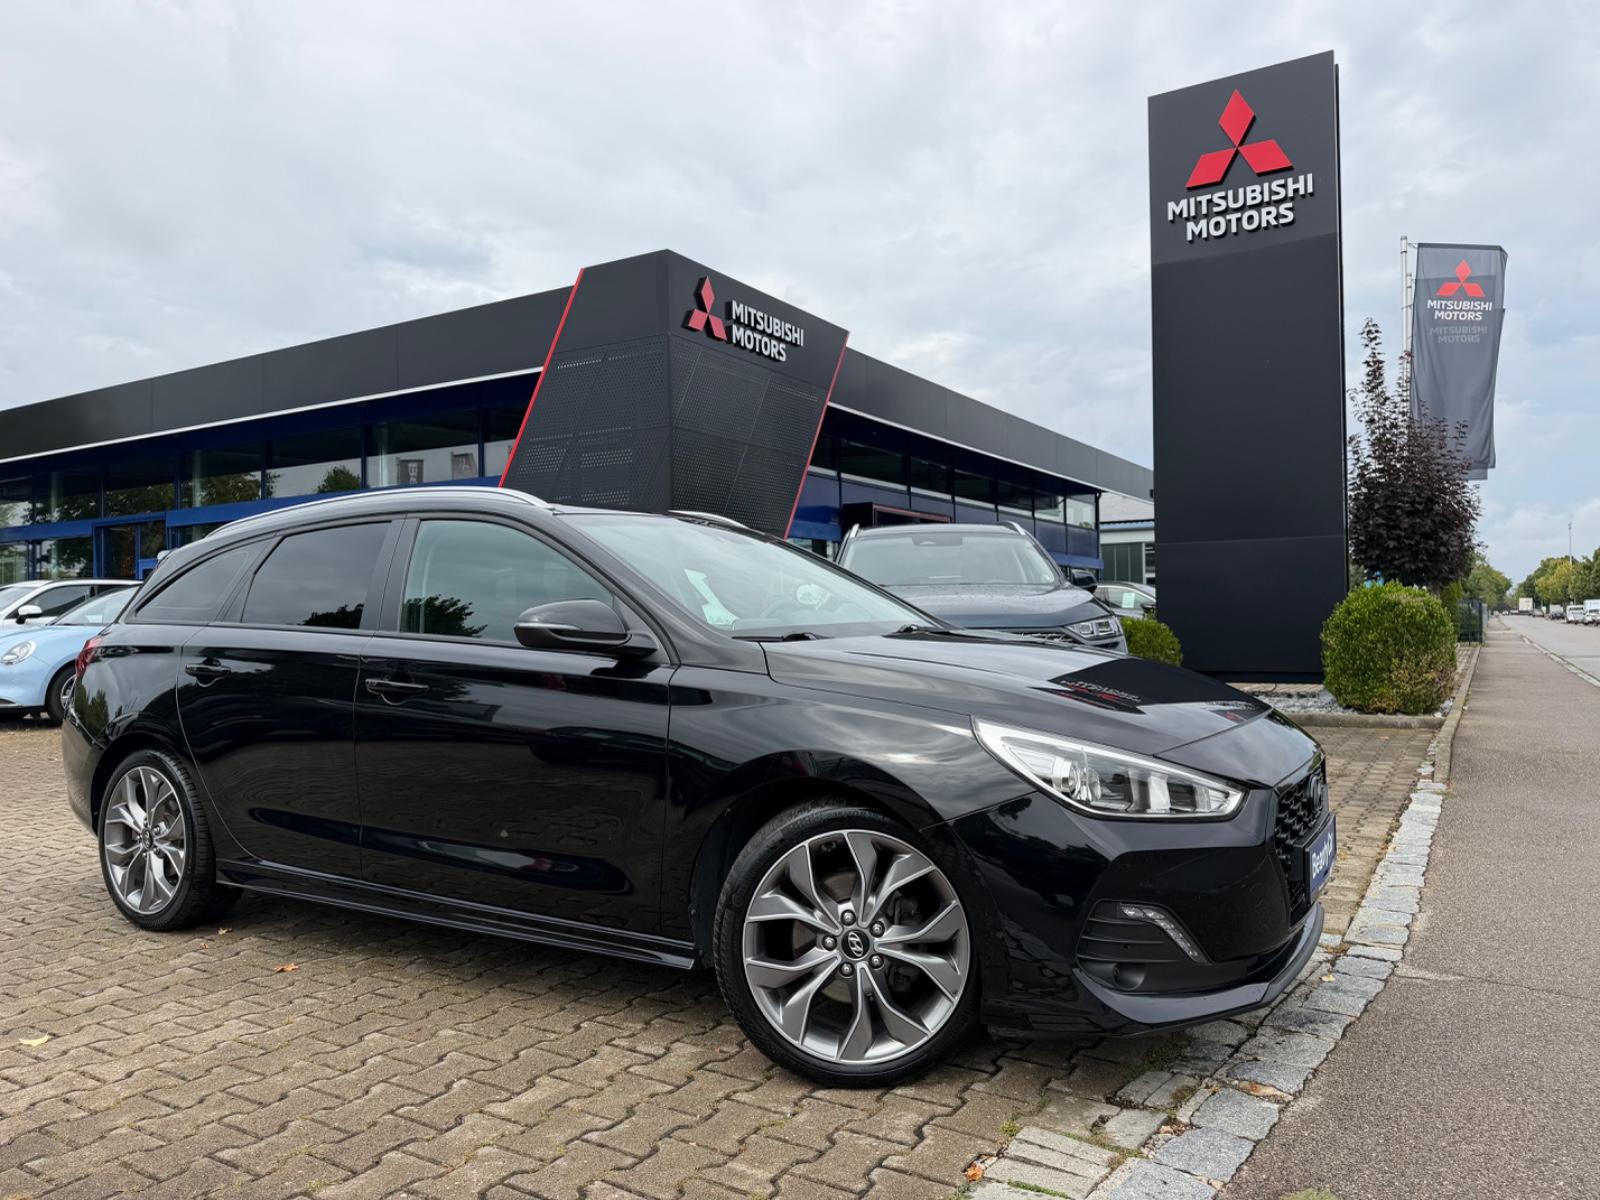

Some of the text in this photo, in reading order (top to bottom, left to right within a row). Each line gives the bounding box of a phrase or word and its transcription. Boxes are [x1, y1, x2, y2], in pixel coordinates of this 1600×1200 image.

[1167, 172, 1313, 221] MITSUBISHI
[1186, 202, 1294, 241] MOTORS
[732, 300, 804, 347] MITSUBISHI
[1427, 299, 1493, 311] MITSUBISHI
[1434, 311, 1483, 321] MOTORS
[732, 325, 787, 362] MOTORS
